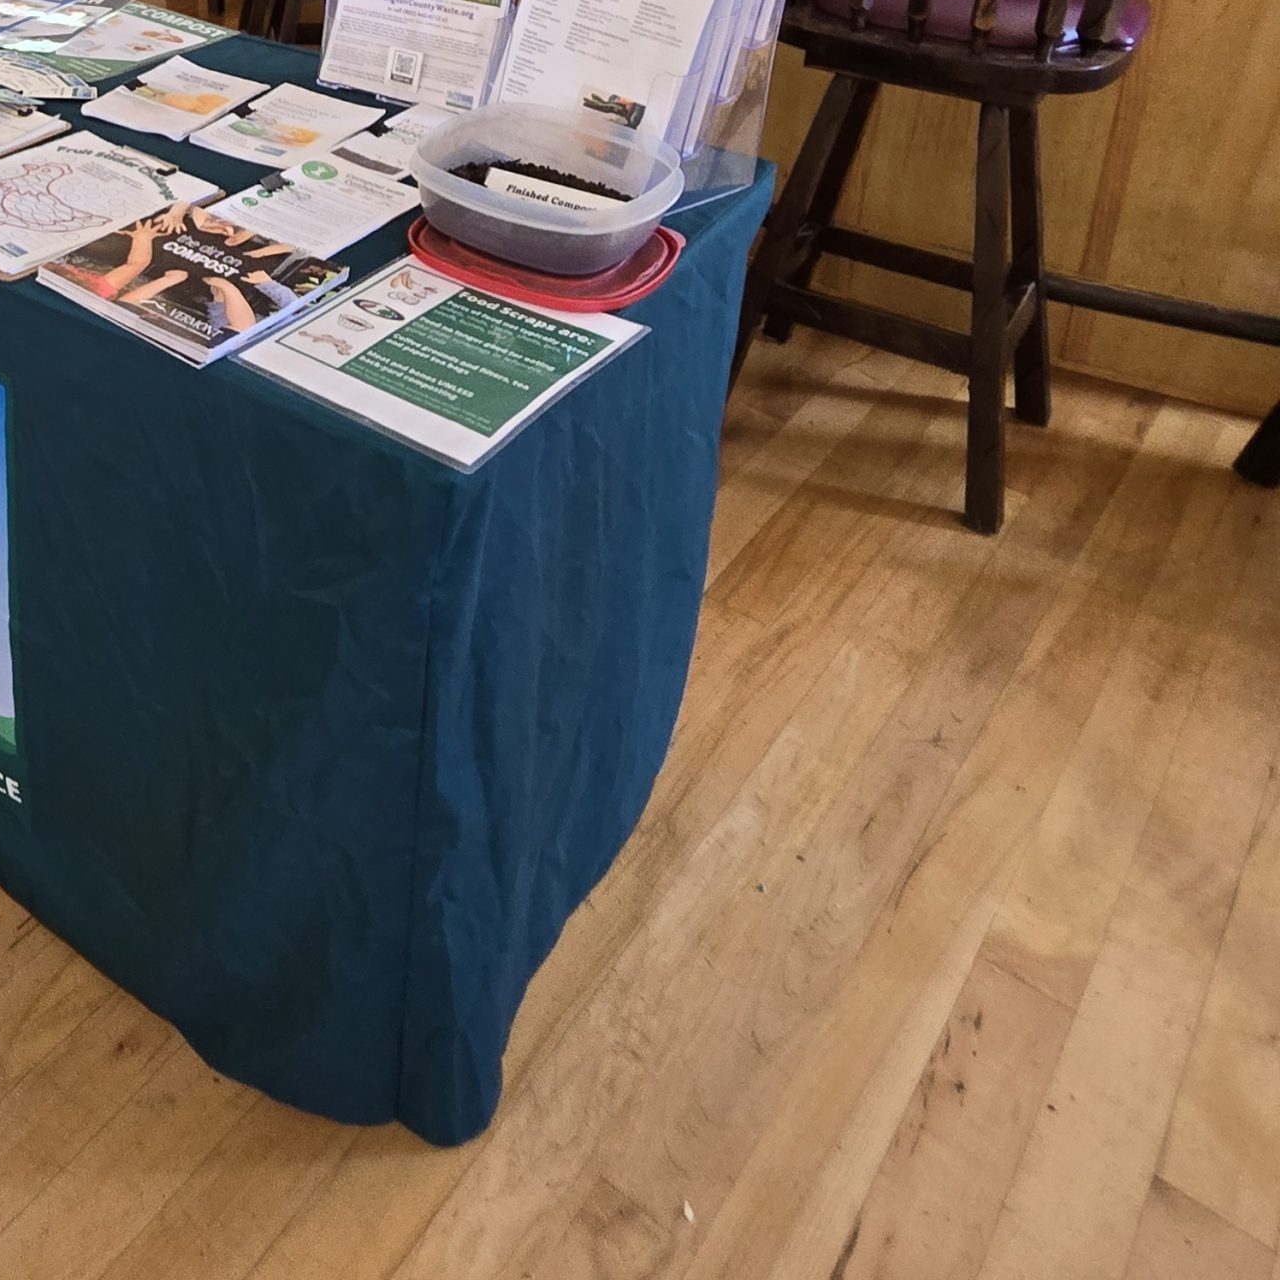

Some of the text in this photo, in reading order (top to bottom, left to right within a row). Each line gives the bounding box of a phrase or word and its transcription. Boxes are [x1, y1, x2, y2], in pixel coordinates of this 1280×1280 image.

[141, 7, 227, 37] COMPOST
[56, 145, 94, 155] Fruit
[506, 184, 549, 202] Finished
[163, 241, 241, 278] COMPOST
[177, 234, 243, 267] the dirt on
[169, 308, 225, 337] VERMONT
[458, 291, 500, 310] Food
[501, 306, 557, 332] Scraps
[558, 328, 595, 346] are:
[385, 338, 470, 376] and paper tea bags
[393, 333, 422, 348] Coffee
[421, 345, 460, 363] grounds
[460, 359, 480, 370] and
[390, 360, 410, 372] and
[408, 367, 437, 384] bones
[438, 379, 474, 398] UNLESS
[403, 375, 458, 401] composting
